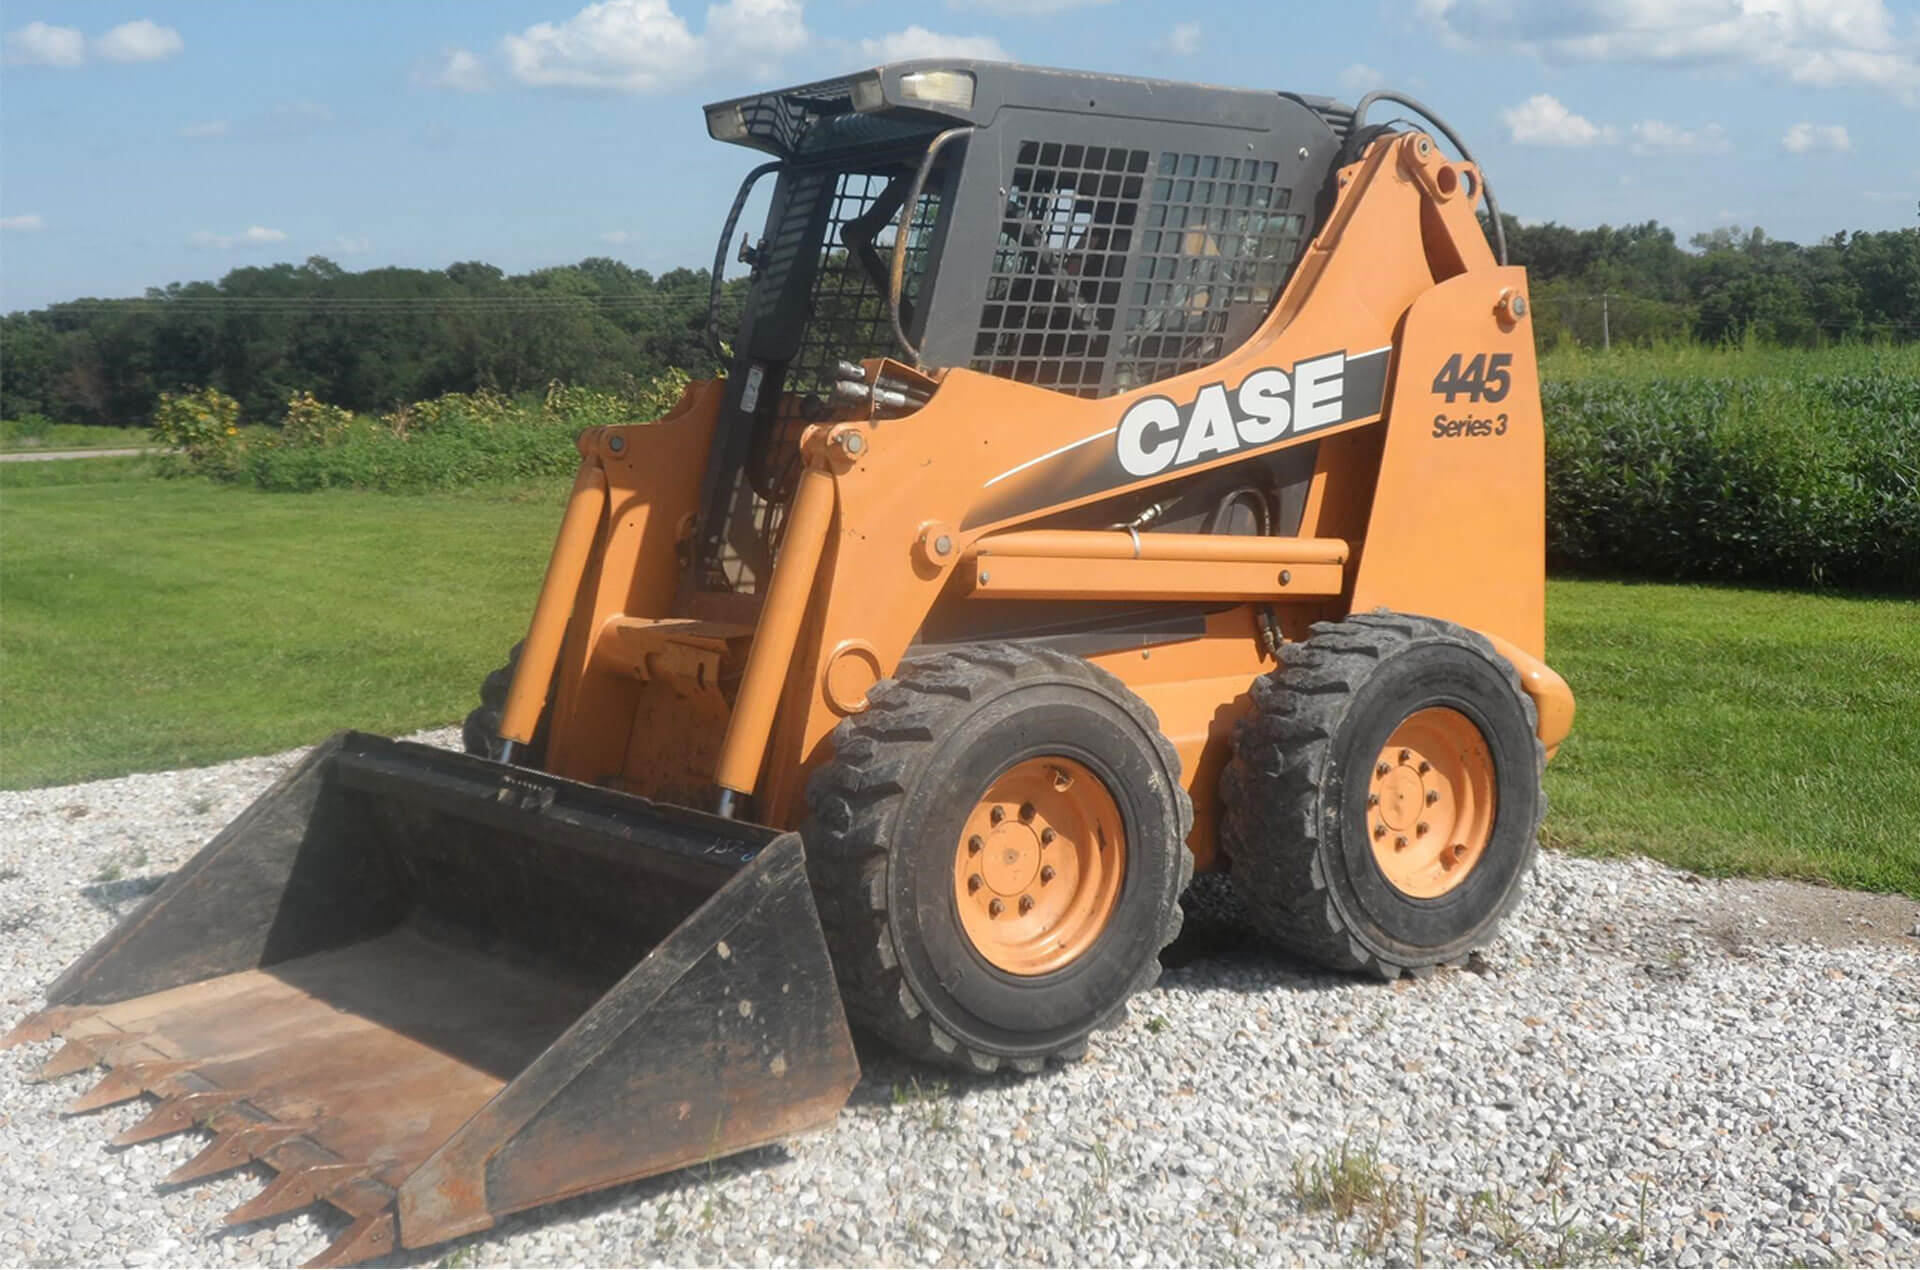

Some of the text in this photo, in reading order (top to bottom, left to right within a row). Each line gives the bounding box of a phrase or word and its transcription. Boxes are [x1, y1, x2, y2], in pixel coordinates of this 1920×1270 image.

[1431, 353, 1513, 404] 445
[1116, 352, 1346, 477] CASE
[1431, 413, 1508, 439] Series 3
